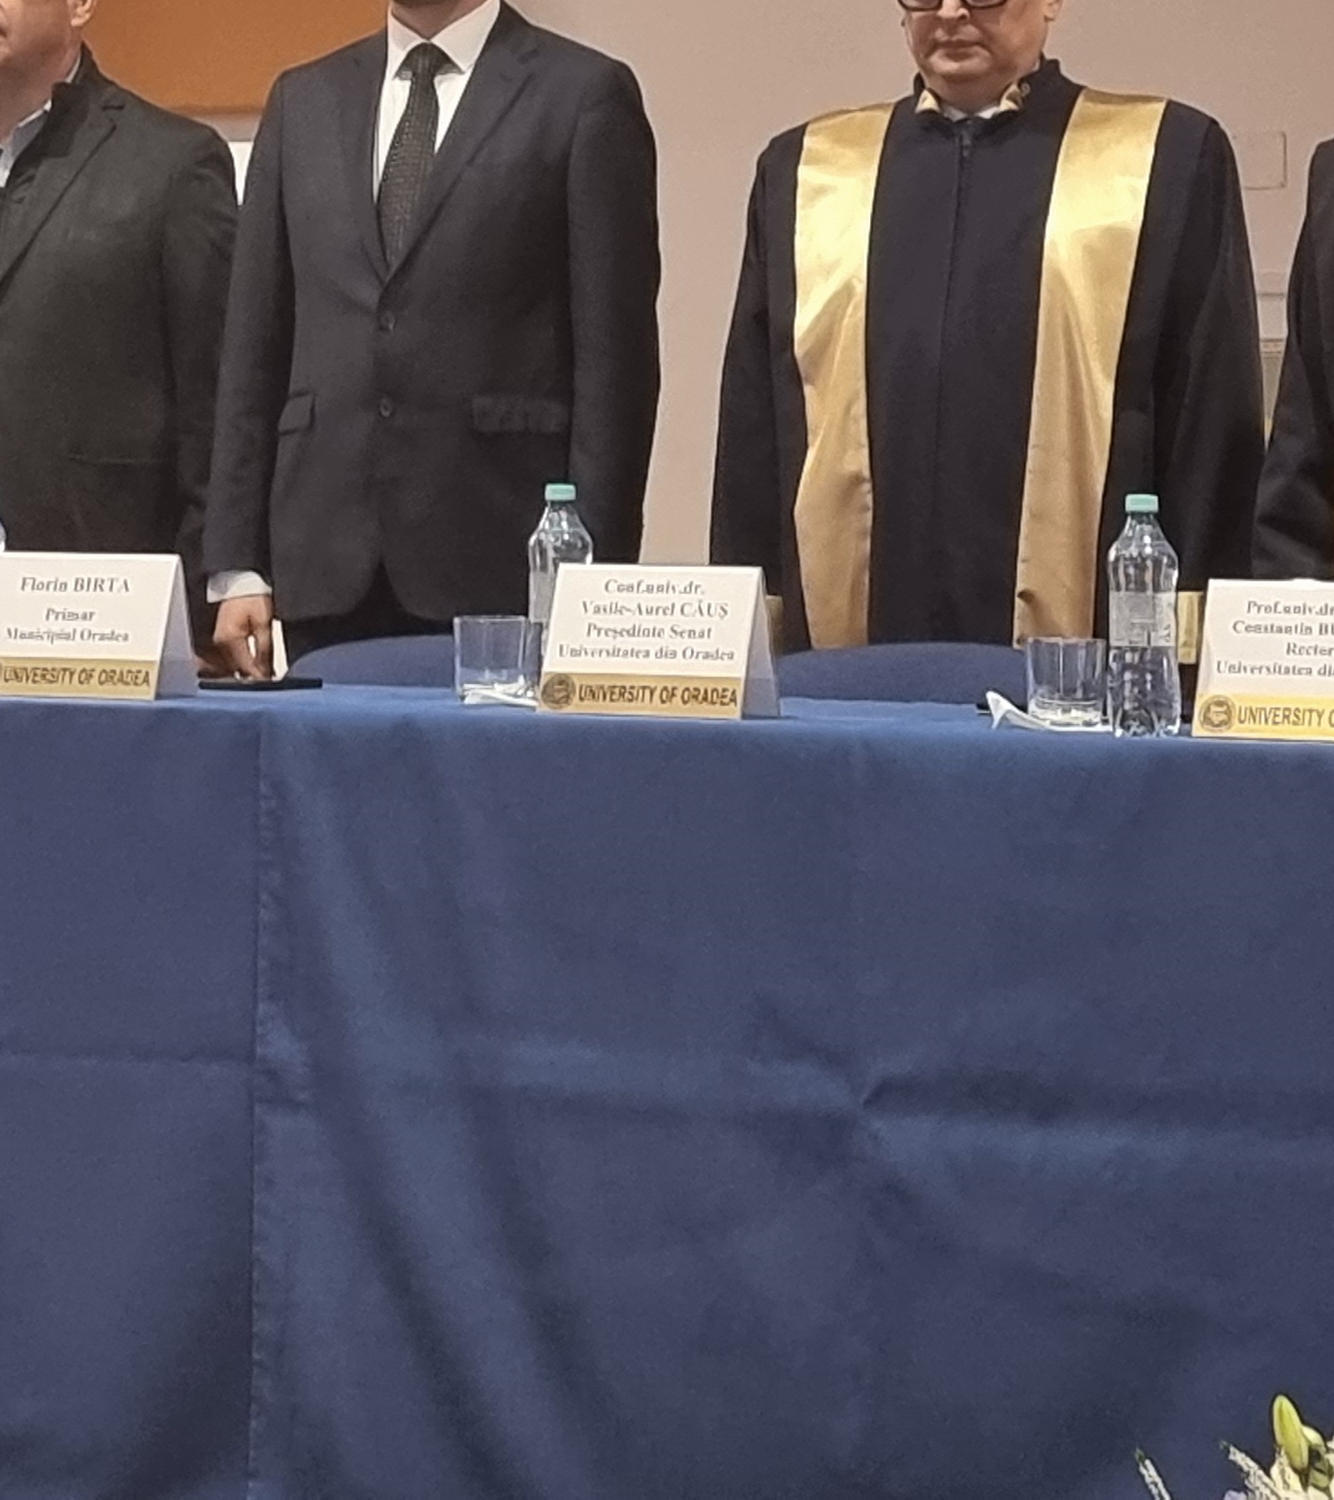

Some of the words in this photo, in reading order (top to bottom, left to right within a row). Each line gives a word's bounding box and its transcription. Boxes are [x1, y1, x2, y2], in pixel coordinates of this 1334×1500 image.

[21, 577, 68, 592] Florin
[74, 578, 130, 593] BIRTA
[45, 608, 96, 621] Primar
[582, 601, 675, 617] Vasile-Aurel
[80, 629, 129, 642] Oradea
[669, 624, 712, 639] Senat
[1232, 620, 1313, 635] Constantin
[558, 644, 650, 659] Universitatea
[655, 645, 677, 659] din
[682, 646, 735, 661] Oradea
[1286, 642, 1334, 657] Rector
[1216, 660, 1313, 676] Universitatea
[4, 666, 76, 684] UNIVERSITY
[78, 668, 93, 685] OF
[98, 669, 150, 687] ORADEA
[578, 684, 657, 704] UNIVERSITY
[659, 686, 678, 704] OF
[682, 687, 737, 707] ORADEA
[1238, 706, 1325, 726] UNIVERSITY
